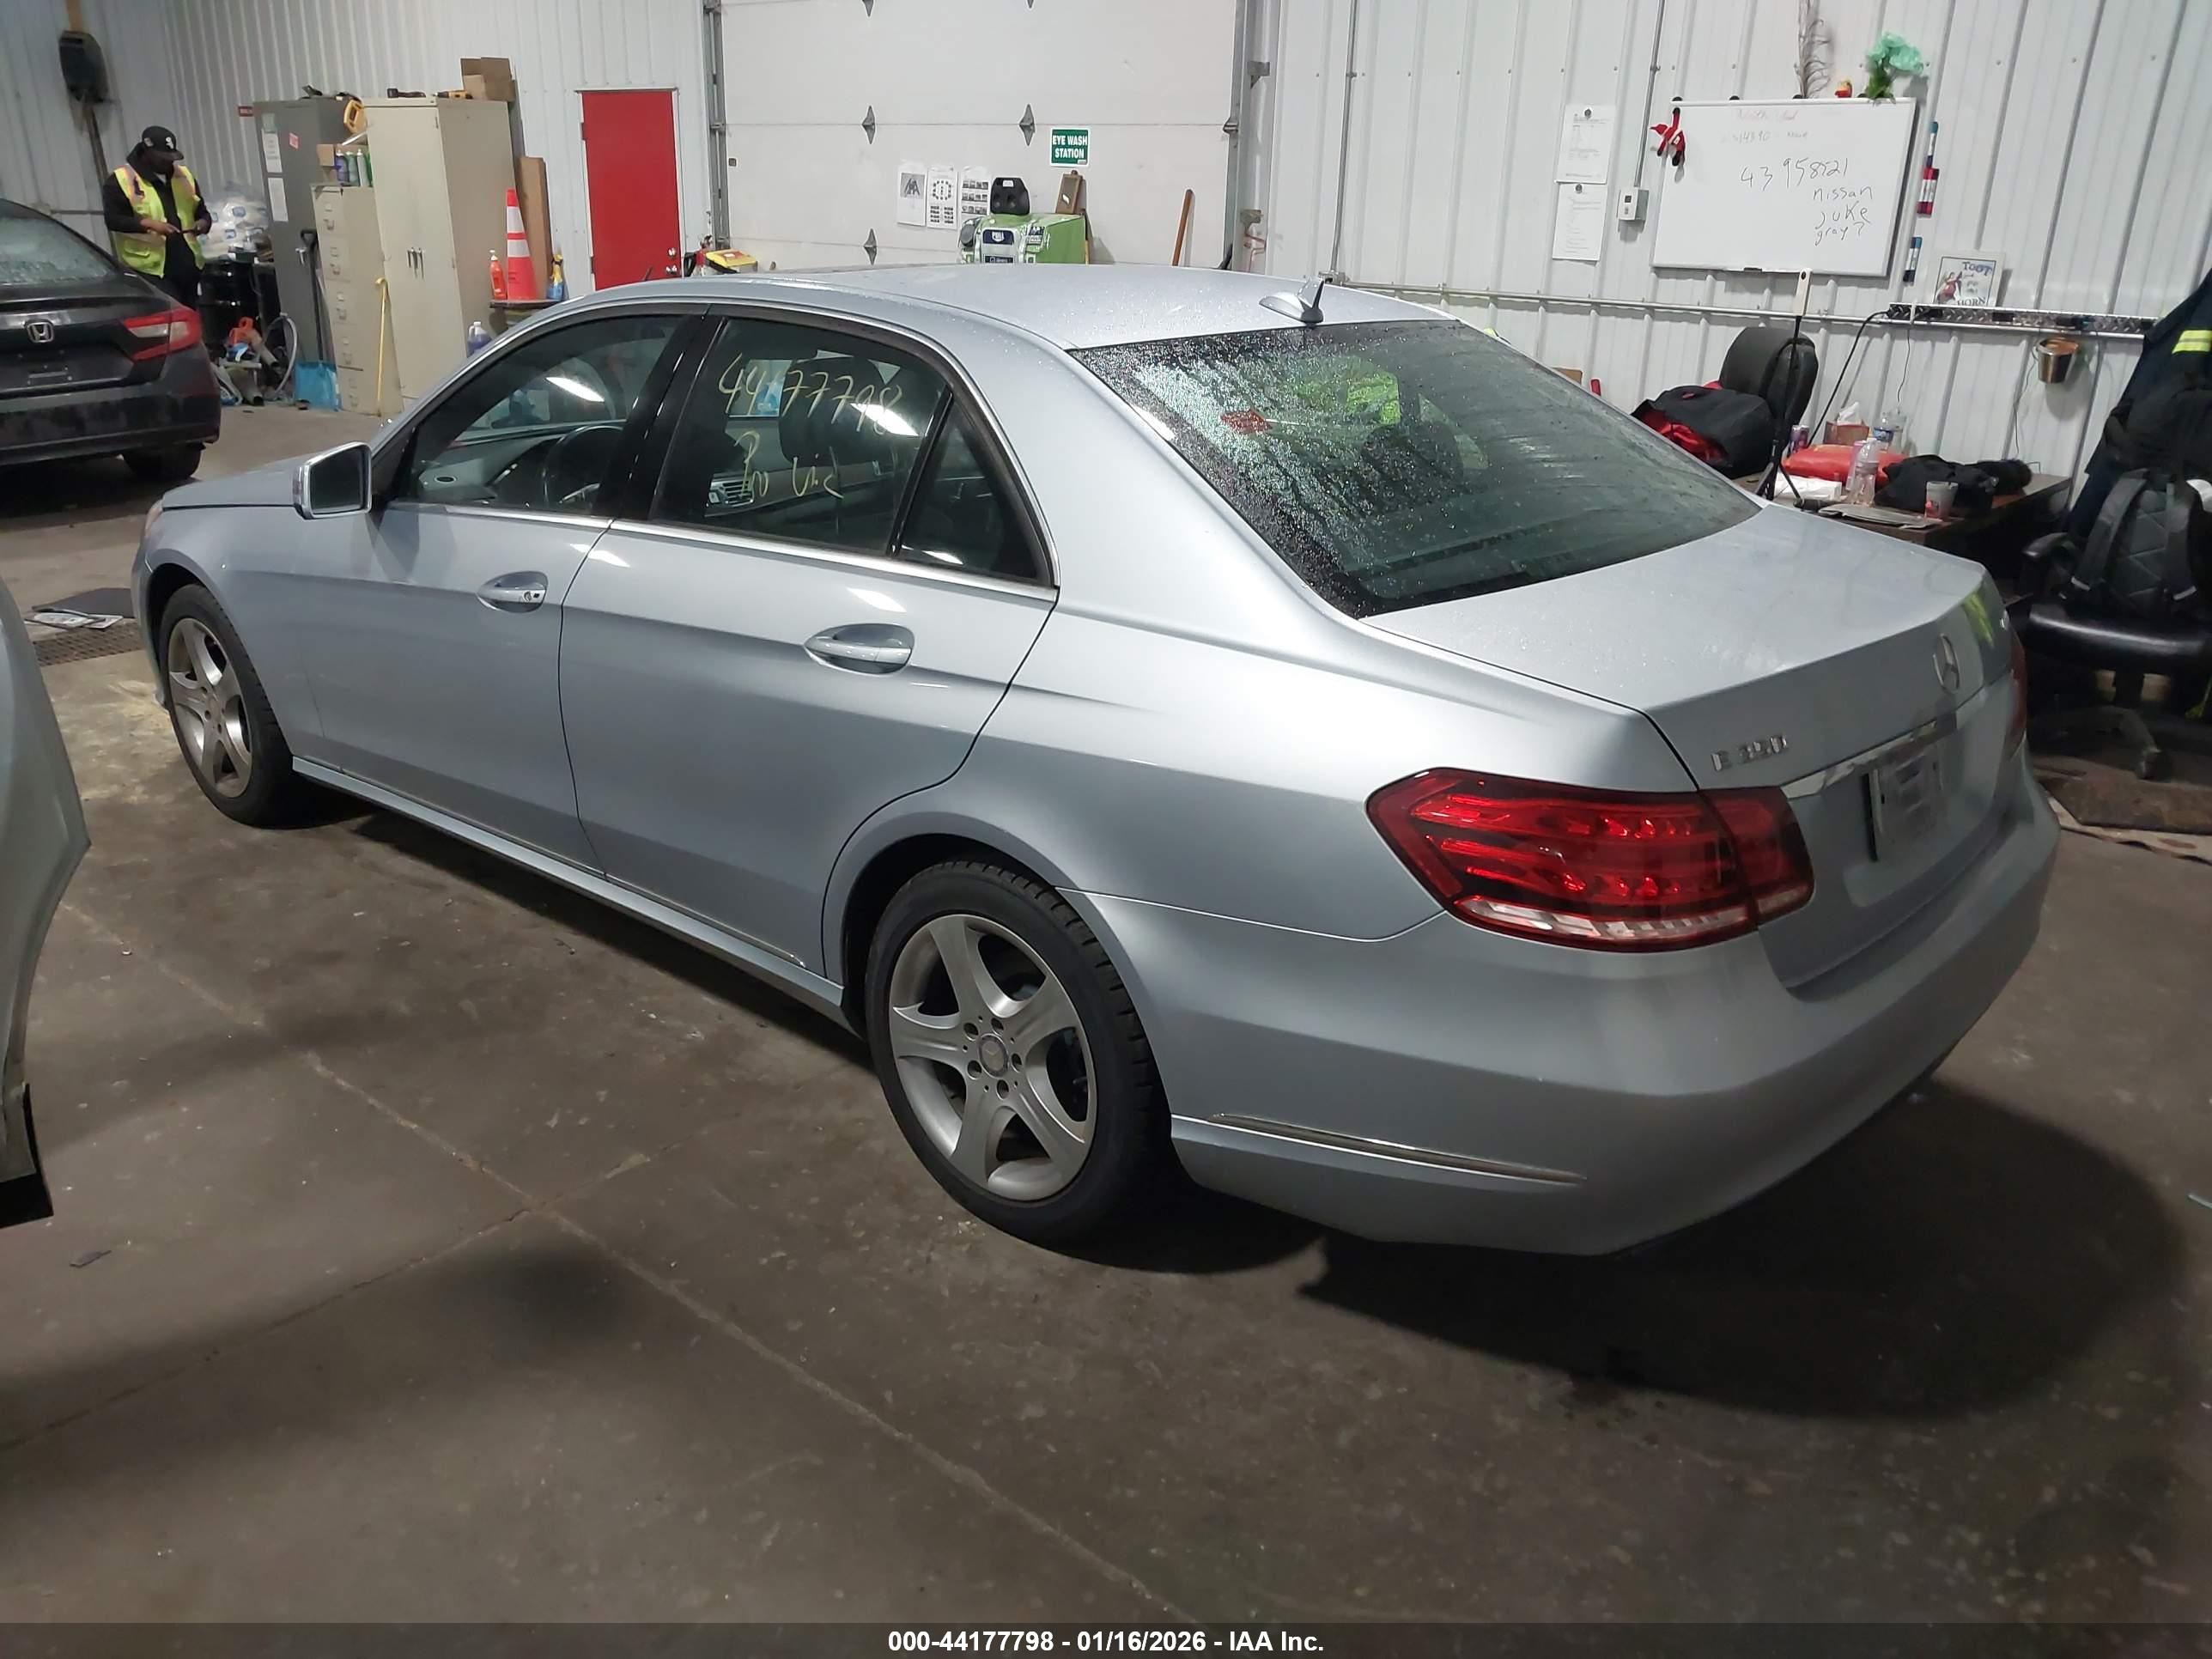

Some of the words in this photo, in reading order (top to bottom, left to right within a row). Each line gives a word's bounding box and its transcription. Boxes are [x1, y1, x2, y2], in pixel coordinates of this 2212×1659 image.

[1053, 135, 1066, 145] EYE
[1067, 135, 1088, 146] WASH
[1054, 148, 1085, 159] STATION
[1962, 261, 1993, 276] TOOT
